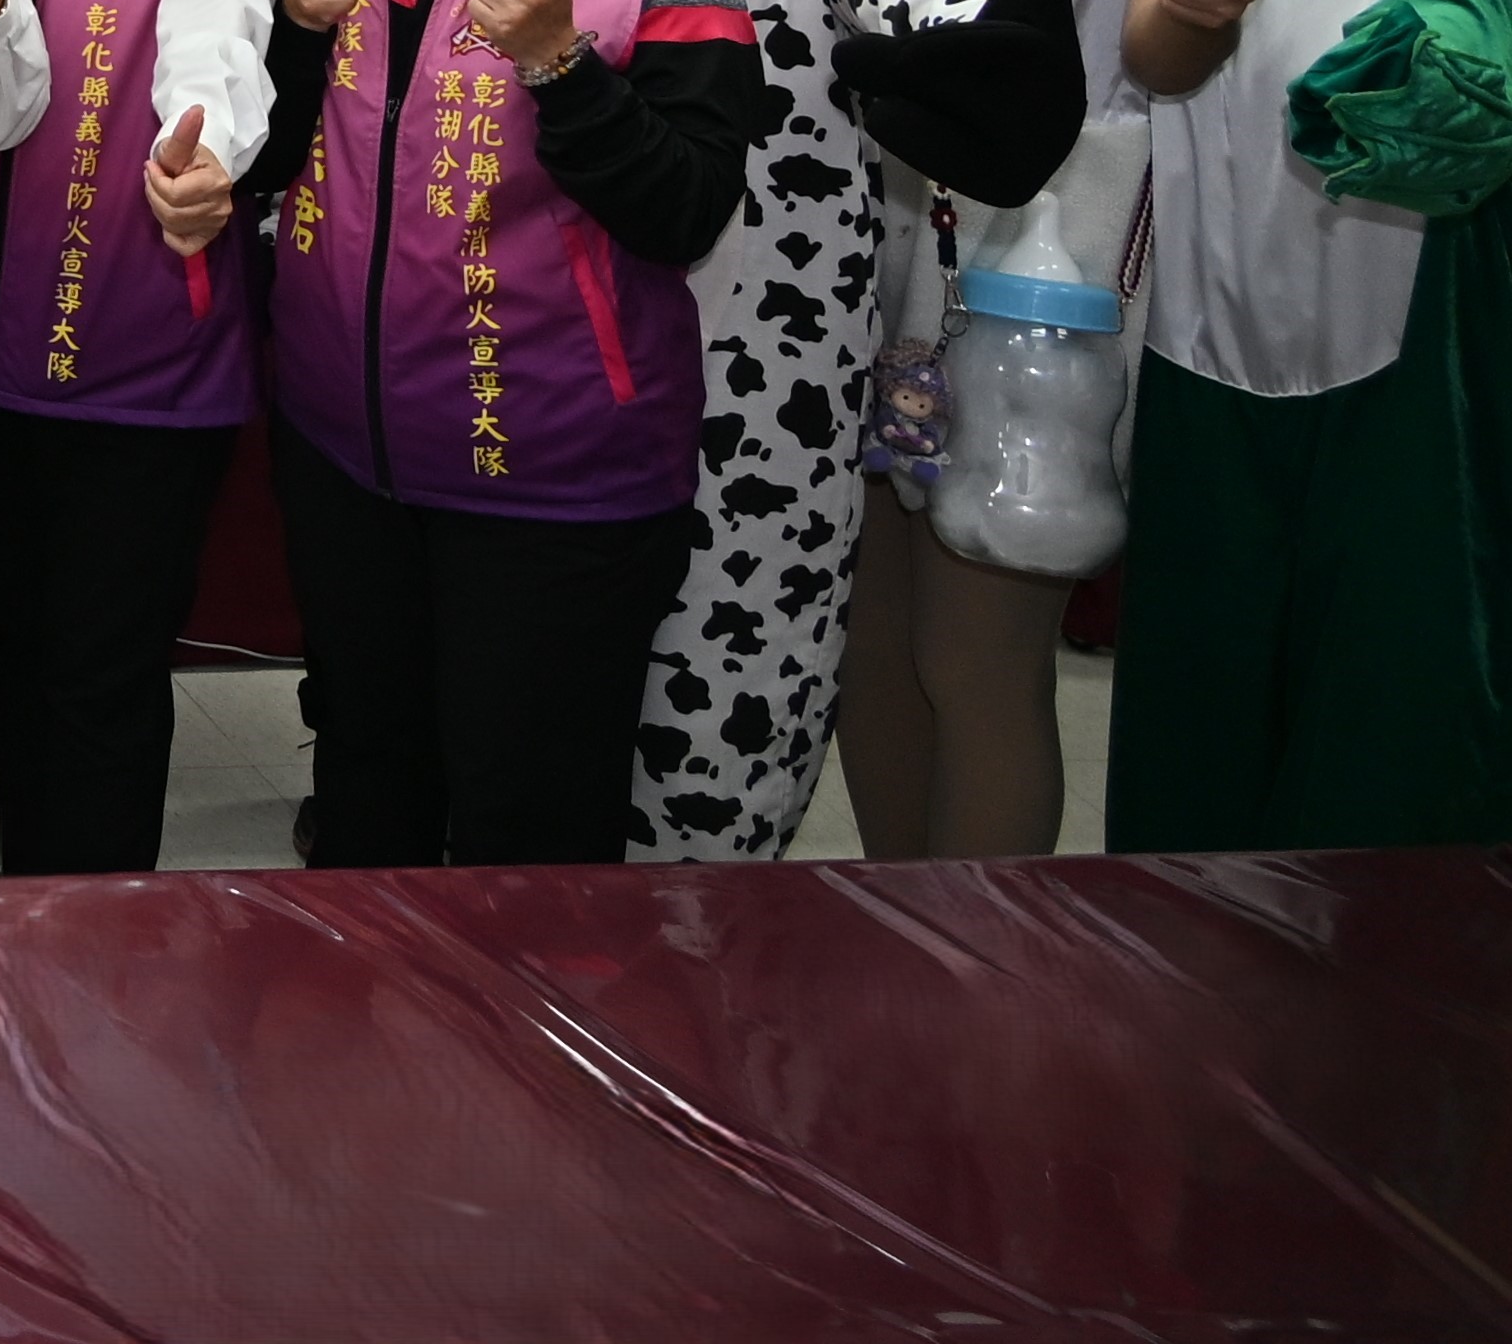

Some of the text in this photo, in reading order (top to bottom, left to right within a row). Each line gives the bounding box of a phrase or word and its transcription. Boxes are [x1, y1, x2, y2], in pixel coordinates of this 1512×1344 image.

[47, 4, 117, 381] 彰化縣義消防火宣導大隊
[426, 70, 465, 218] 溪湖分隊
[462, 74, 509, 476] 彰化縣義消防火宣導大隊
